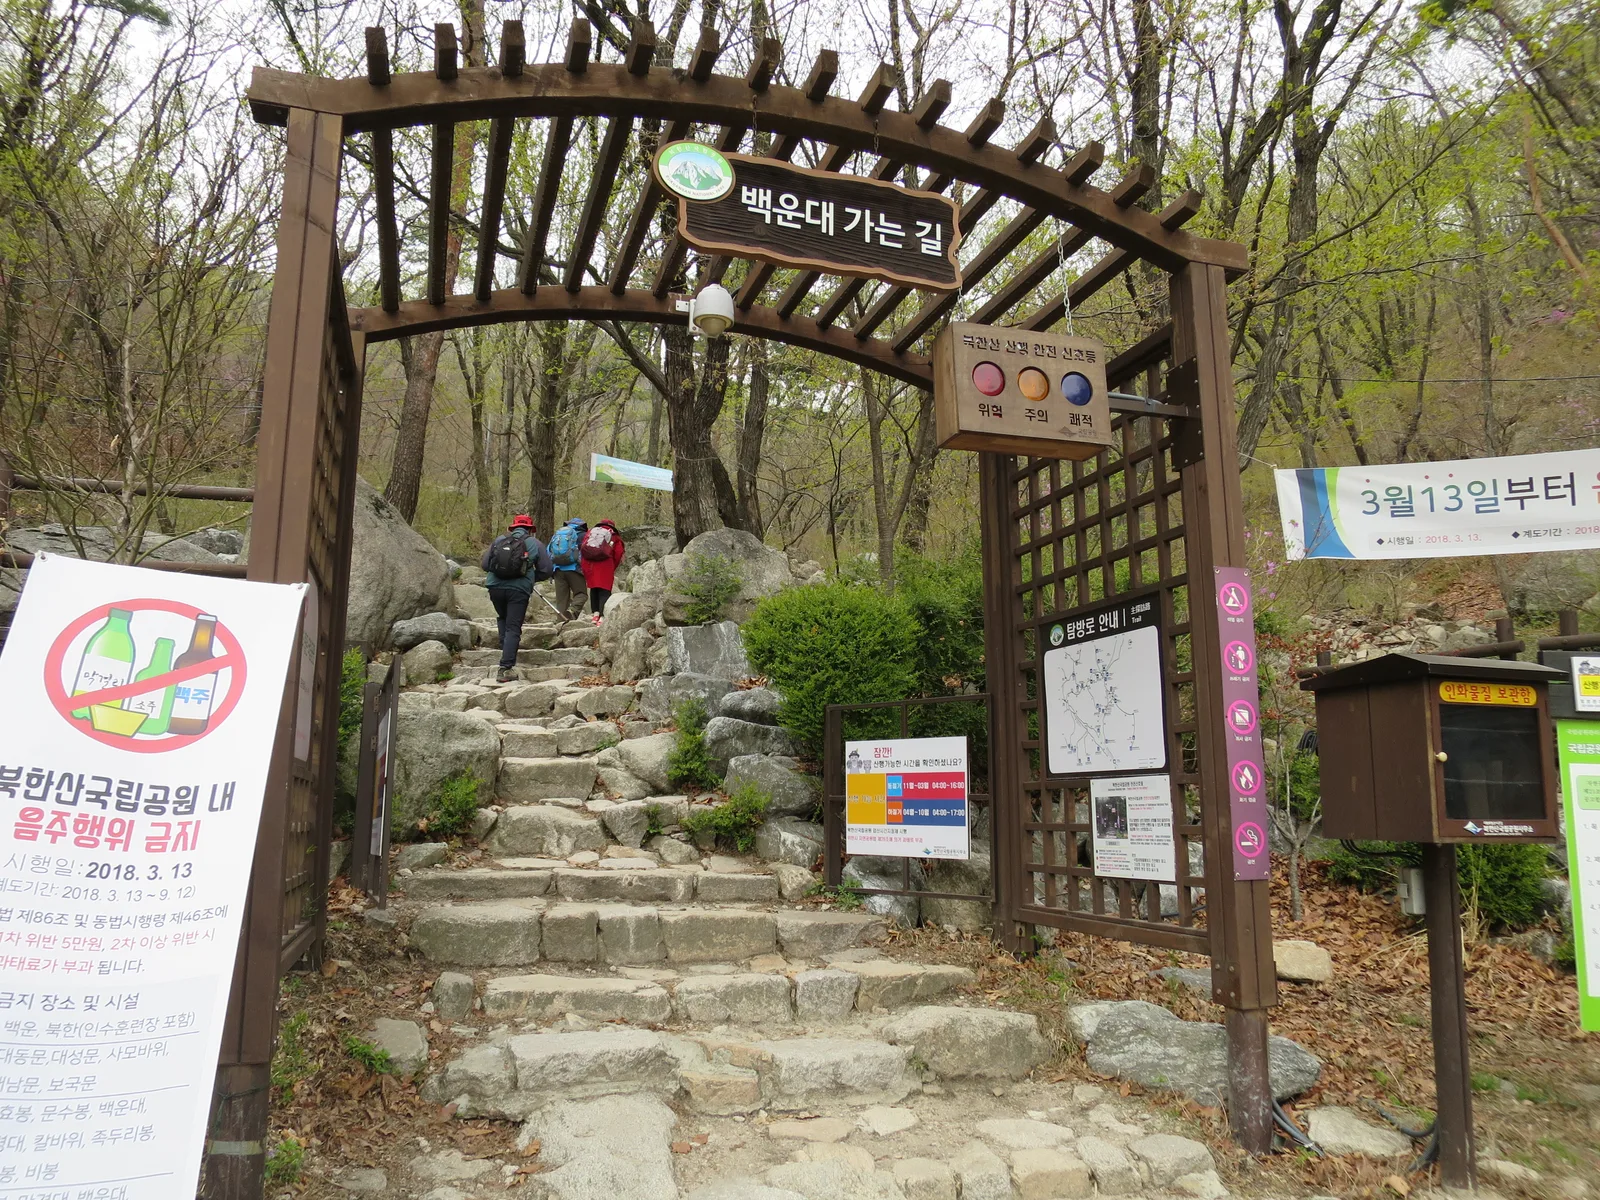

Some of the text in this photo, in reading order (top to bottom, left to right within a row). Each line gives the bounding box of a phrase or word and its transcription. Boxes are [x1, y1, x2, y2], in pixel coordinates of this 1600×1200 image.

[741, 185, 943, 257] 백운대 가는 길
[963, 335, 1096, 363] 북한산 산행 안전 신호등
[978, 403, 1093, 427] 위험 주의 쾌적
[1387, 535, 1414, 546] 시행일
[1425, 534, 1451, 545] 2018.
[1455, 533, 1464, 543] 3.
[1467, 532, 1482, 542] 13.
[1523, 527, 1562, 538] 계도기간
[1066, 610, 1119, 640] 탐방로 안내
[1131, 615, 1142, 624] Trail
[83, 671, 125, 688] 막걸리
[175, 686, 210, 705] 맥주
[1444, 683, 1531, 703] 인화물질 보관함
[135, 700, 156, 715] 소주
[873, 747, 892, 758] 잠깐!
[874, 758, 962, 768] 산행가능한 시간을 확인하셨나요?
[0, 765, 236, 816] 북한산국립공원 내
[13, 806, 201, 853] 음주행위 금지
[147, 865, 163, 881] 3.
[171, 862, 193, 879] 13
[62, 886, 101, 901] 2018.
[107, 890, 119, 902] 3.
[127, 889, 142, 902] 13
[159, 888, 171, 901] 9.
[177, 885, 196, 899] 12)
[17, 908, 69, 926] 제86조
[74, 913, 88, 928] 및
[93, 913, 167, 929] 동법시행령
[169, 904, 229, 925] 제46조에
[25, 932, 57, 949] 위반
[61, 936, 106, 952] 5만원,
[110, 936, 136, 951] 2차
[139, 933, 167, 950] 이상
[171, 931, 199, 947] 위반
[202, 928, 215, 942] 시
[0, 955, 145, 975] 과태료가 부과 됩니다.
[0, 992, 140, 1012] 금지 장소 및 시설
[4, 1011, 196, 1039] 백운, 북한(인수훈련장 포함)
[107, 1041, 170, 1062] 사모바위,
[47, 1074, 97, 1092] 보국문
[41, 1103, 93, 1122] 문수봉,
[99, 1097, 148, 1118] 백운대,
[34, 1132, 86, 1152] 칼바위,
[91, 1124, 156, 1147] 족두리봉,
[0, 1162, 59, 1184] 봉, 비봉
